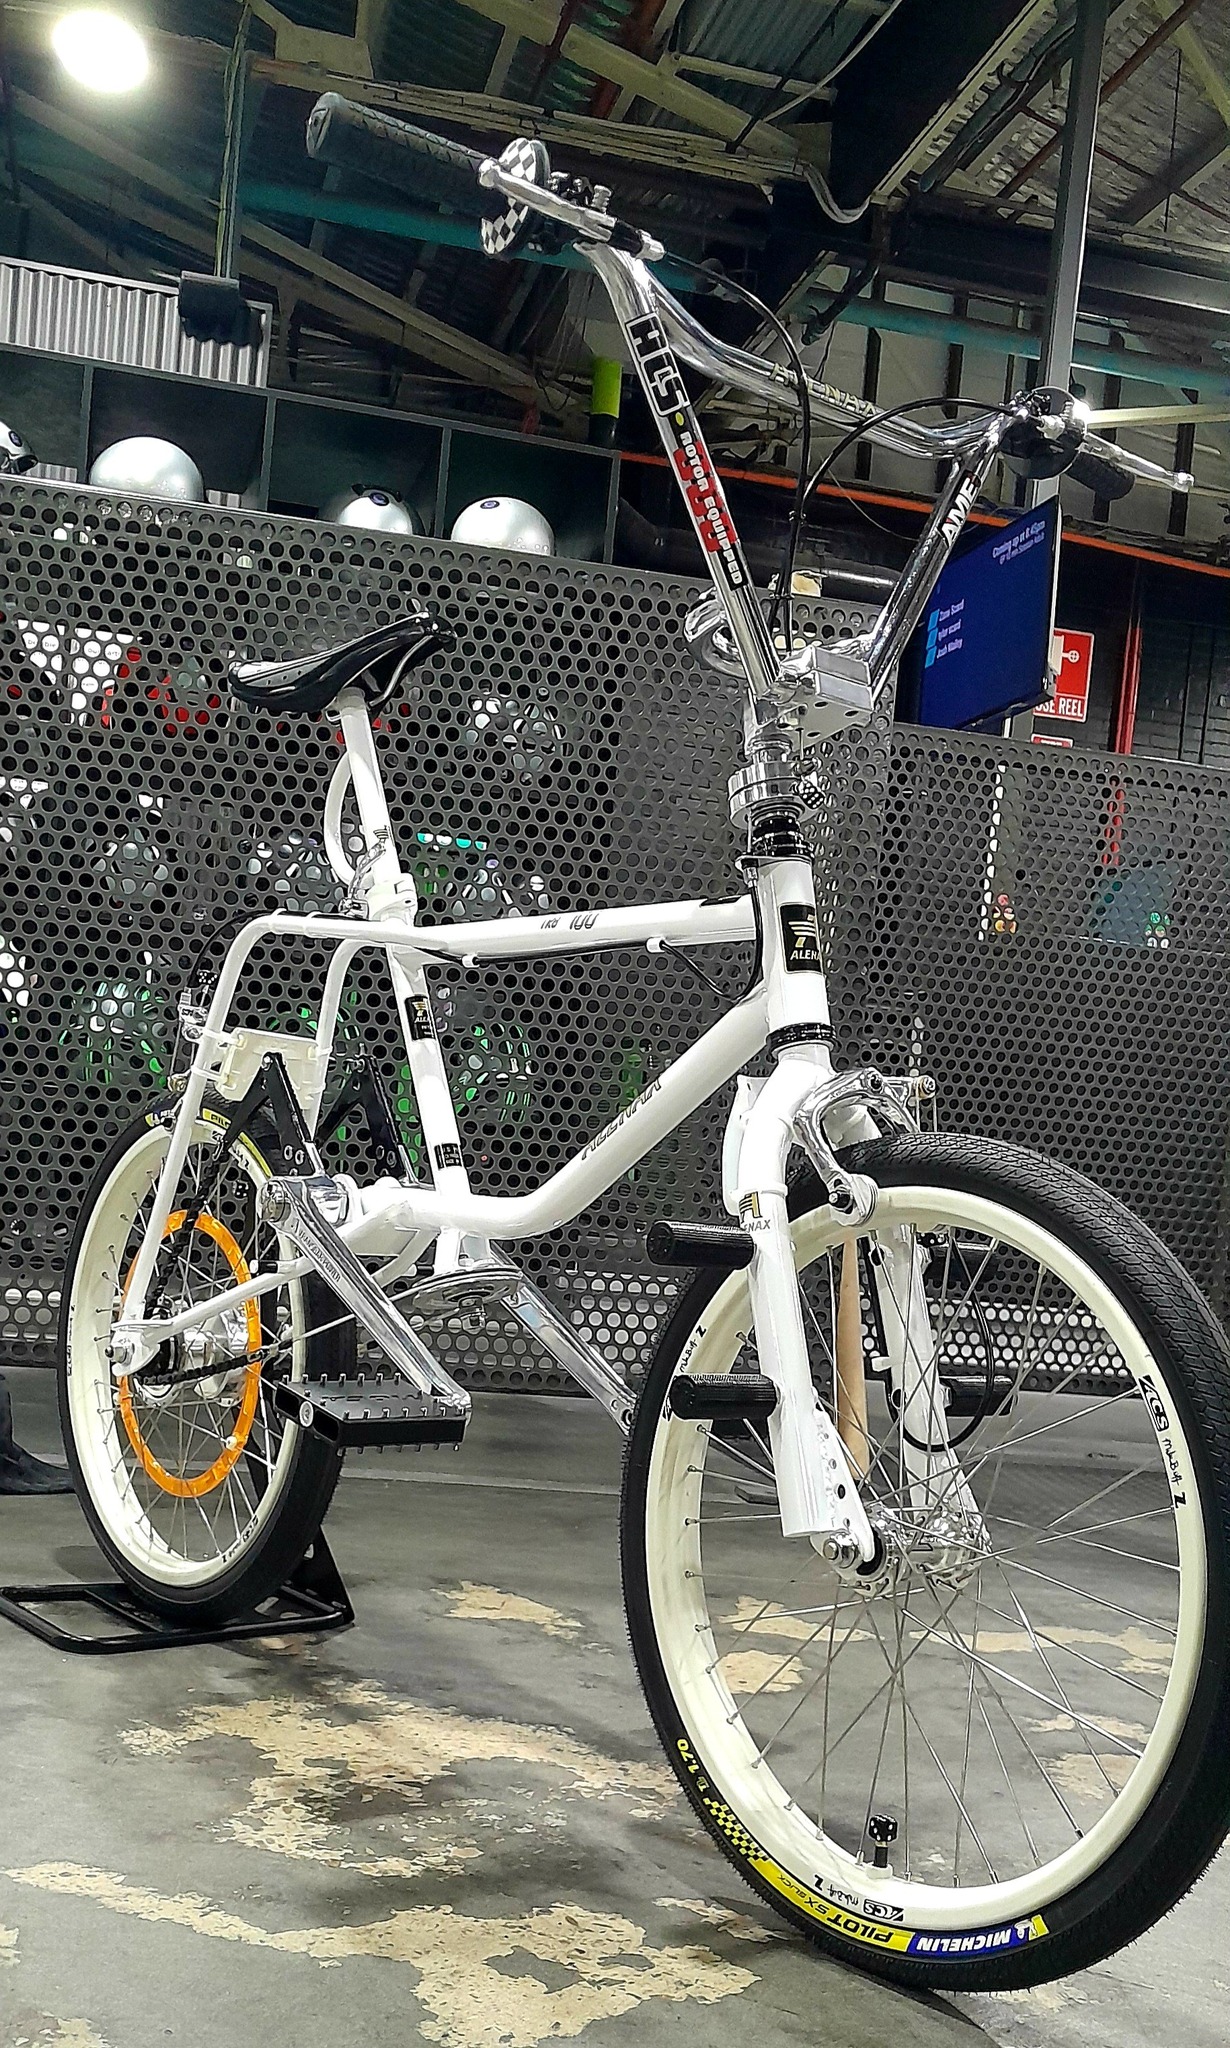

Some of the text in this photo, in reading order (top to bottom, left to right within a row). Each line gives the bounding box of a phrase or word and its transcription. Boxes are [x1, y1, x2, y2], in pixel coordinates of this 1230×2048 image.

[680, 431, 742, 584] ROTOR EQUIPPED
[943, 477, 977, 546] AME
[1059, 697, 1083, 717] REEL
[1140, 1376, 1169, 1432] ACS
[1173, 1491, 1187, 1508] Z
[676, 1738, 700, 1774] 1.70
[777, 1874, 894, 1943] PILOT SX SLICK
[863, 1899, 904, 1922] ACS
[916, 1928, 1012, 1952] MICHELIN
